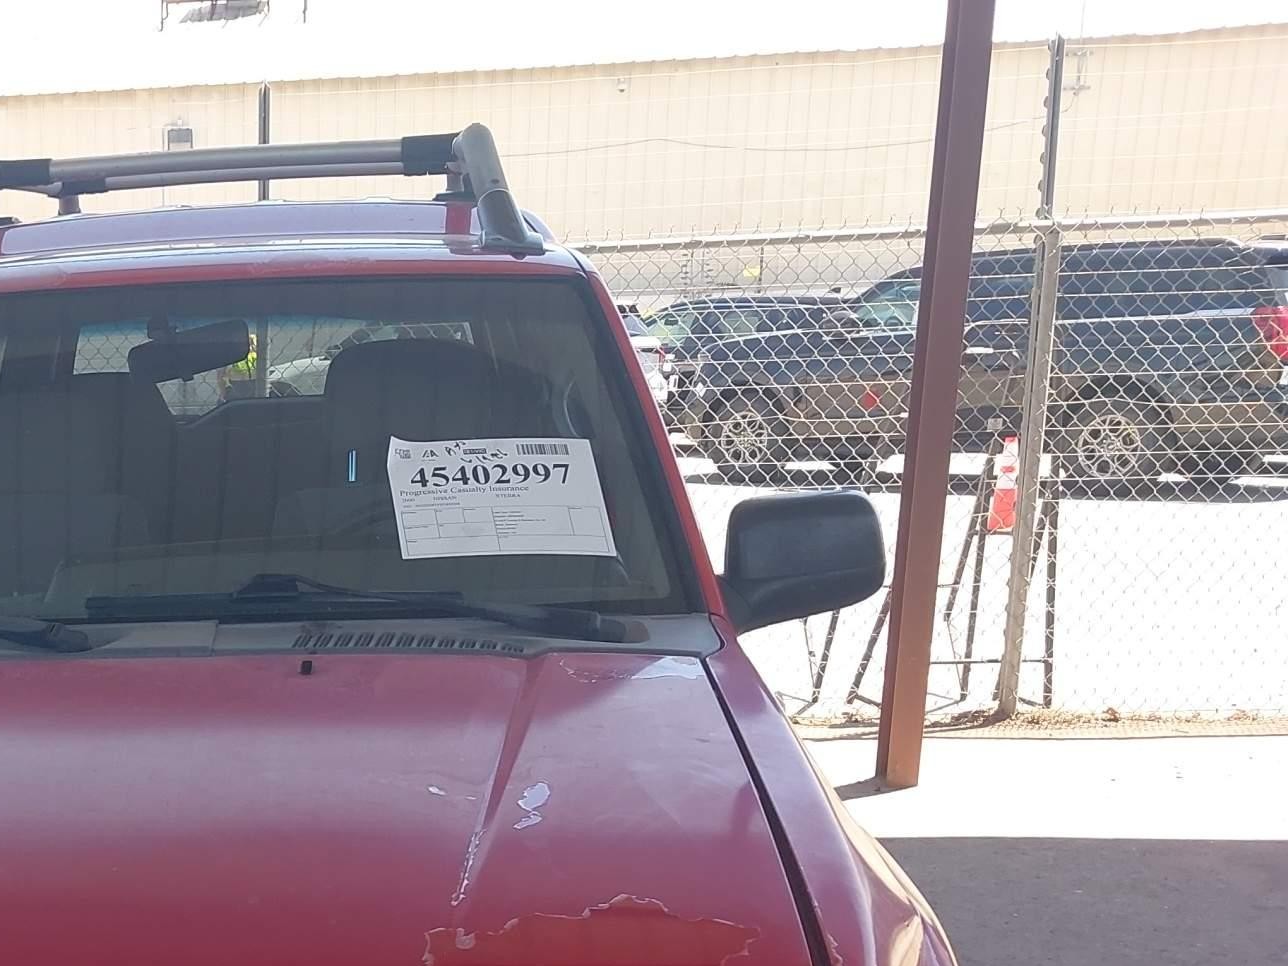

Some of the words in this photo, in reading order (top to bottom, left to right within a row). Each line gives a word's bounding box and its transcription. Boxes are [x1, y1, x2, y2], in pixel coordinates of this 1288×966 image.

[410, 463, 570, 488] 45402997
[400, 488, 448, 497] Progressive
[450, 485, 487, 494] Casualty
